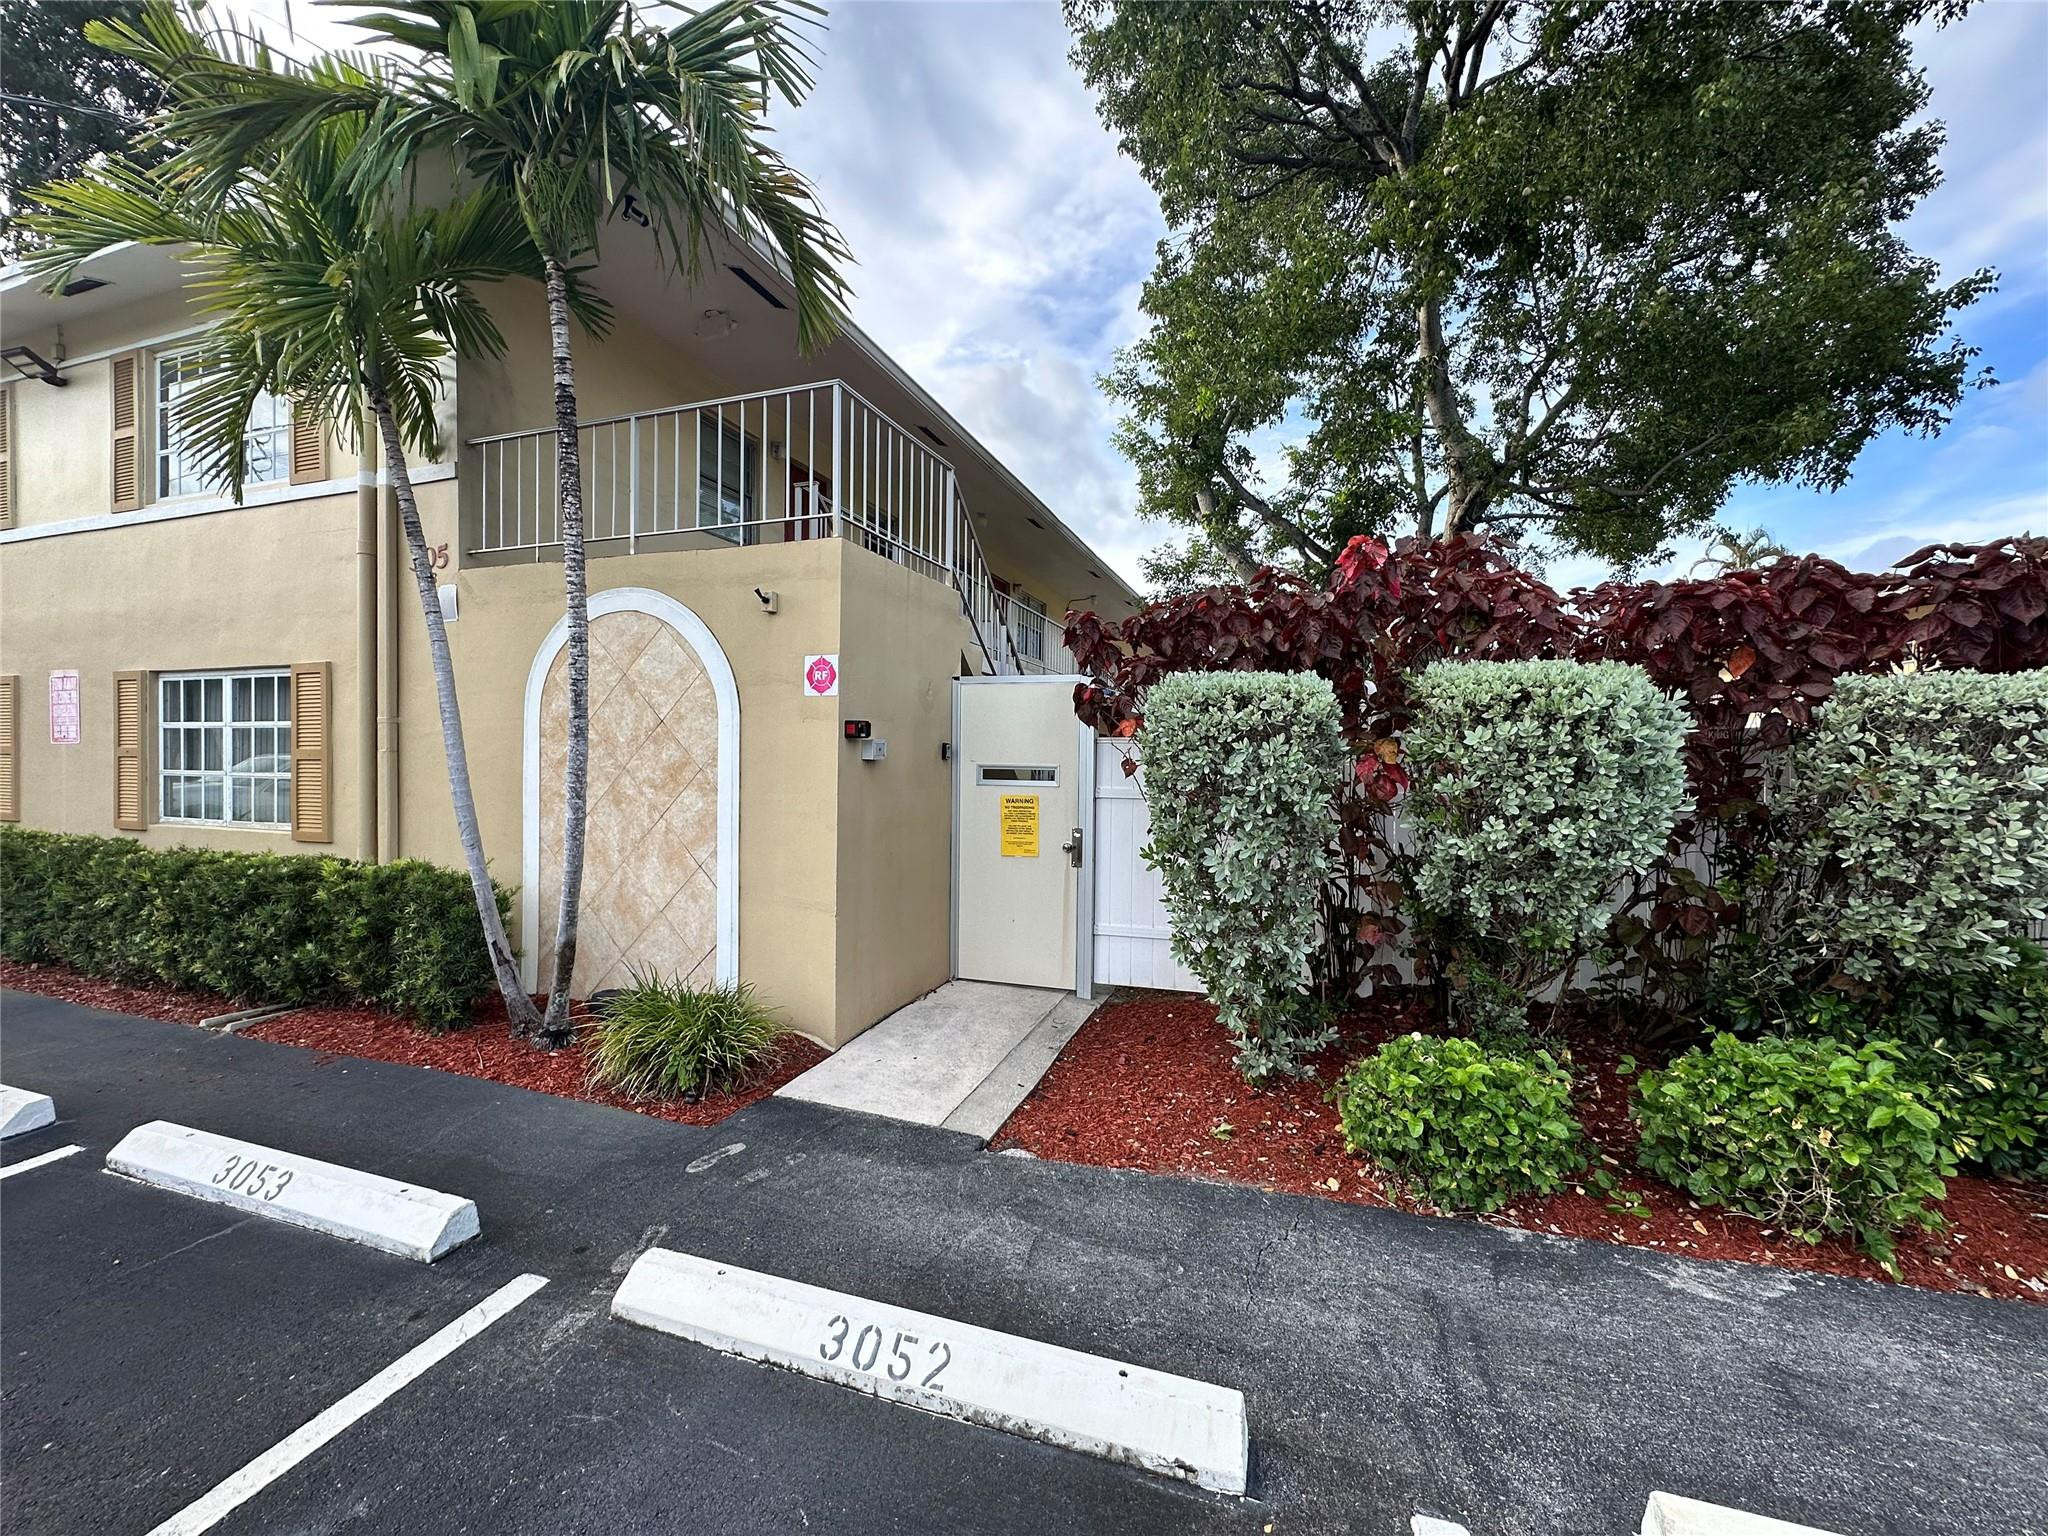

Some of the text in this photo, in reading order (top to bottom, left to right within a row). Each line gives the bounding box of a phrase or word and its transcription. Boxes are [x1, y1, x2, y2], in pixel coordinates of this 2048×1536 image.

[814, 670, 829, 681] RF
[212, 1154, 293, 1201] 3053
[820, 1315, 951, 1392] 3052
